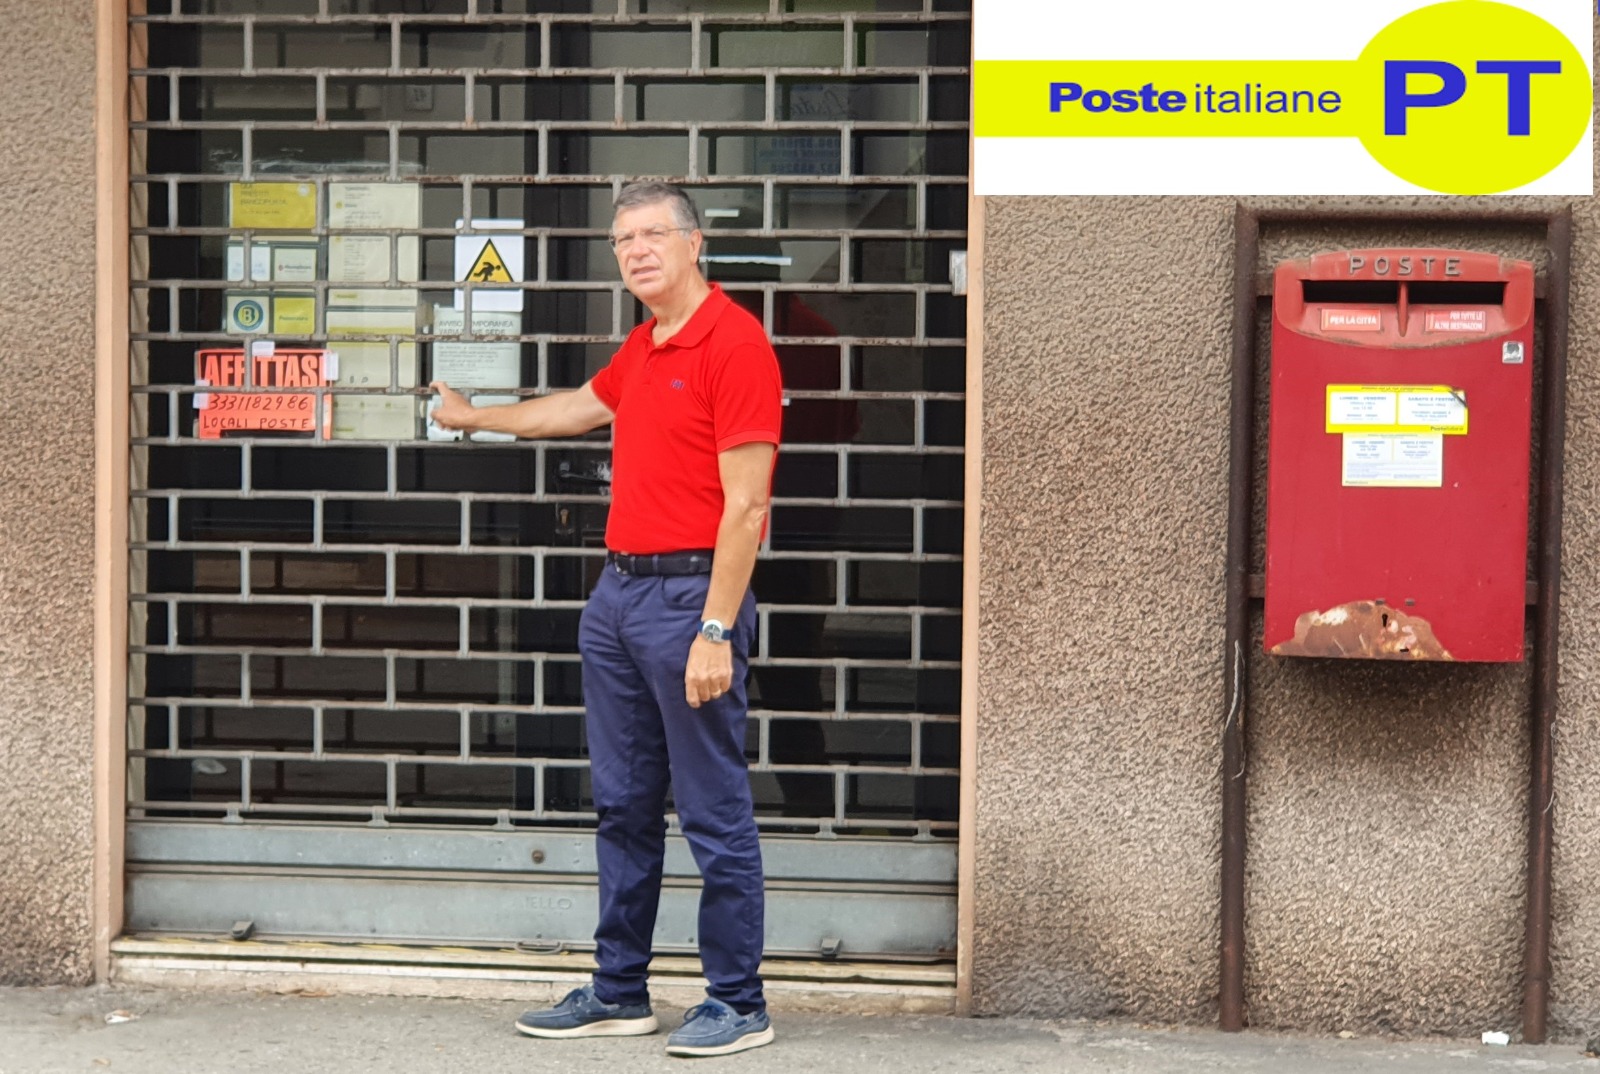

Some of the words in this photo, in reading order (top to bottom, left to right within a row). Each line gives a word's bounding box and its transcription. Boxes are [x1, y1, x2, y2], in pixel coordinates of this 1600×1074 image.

[1349, 256, 1463, 277] POSTE
[1330, 315, 1345, 325] PER
[1345, 315, 1356, 325] LA
[203, 353, 327, 387] AFFITTASI
[210, 393, 309, 411] 3331182986
[203, 415, 248, 429] LOCALI
[260, 417, 310, 430] POSTE
